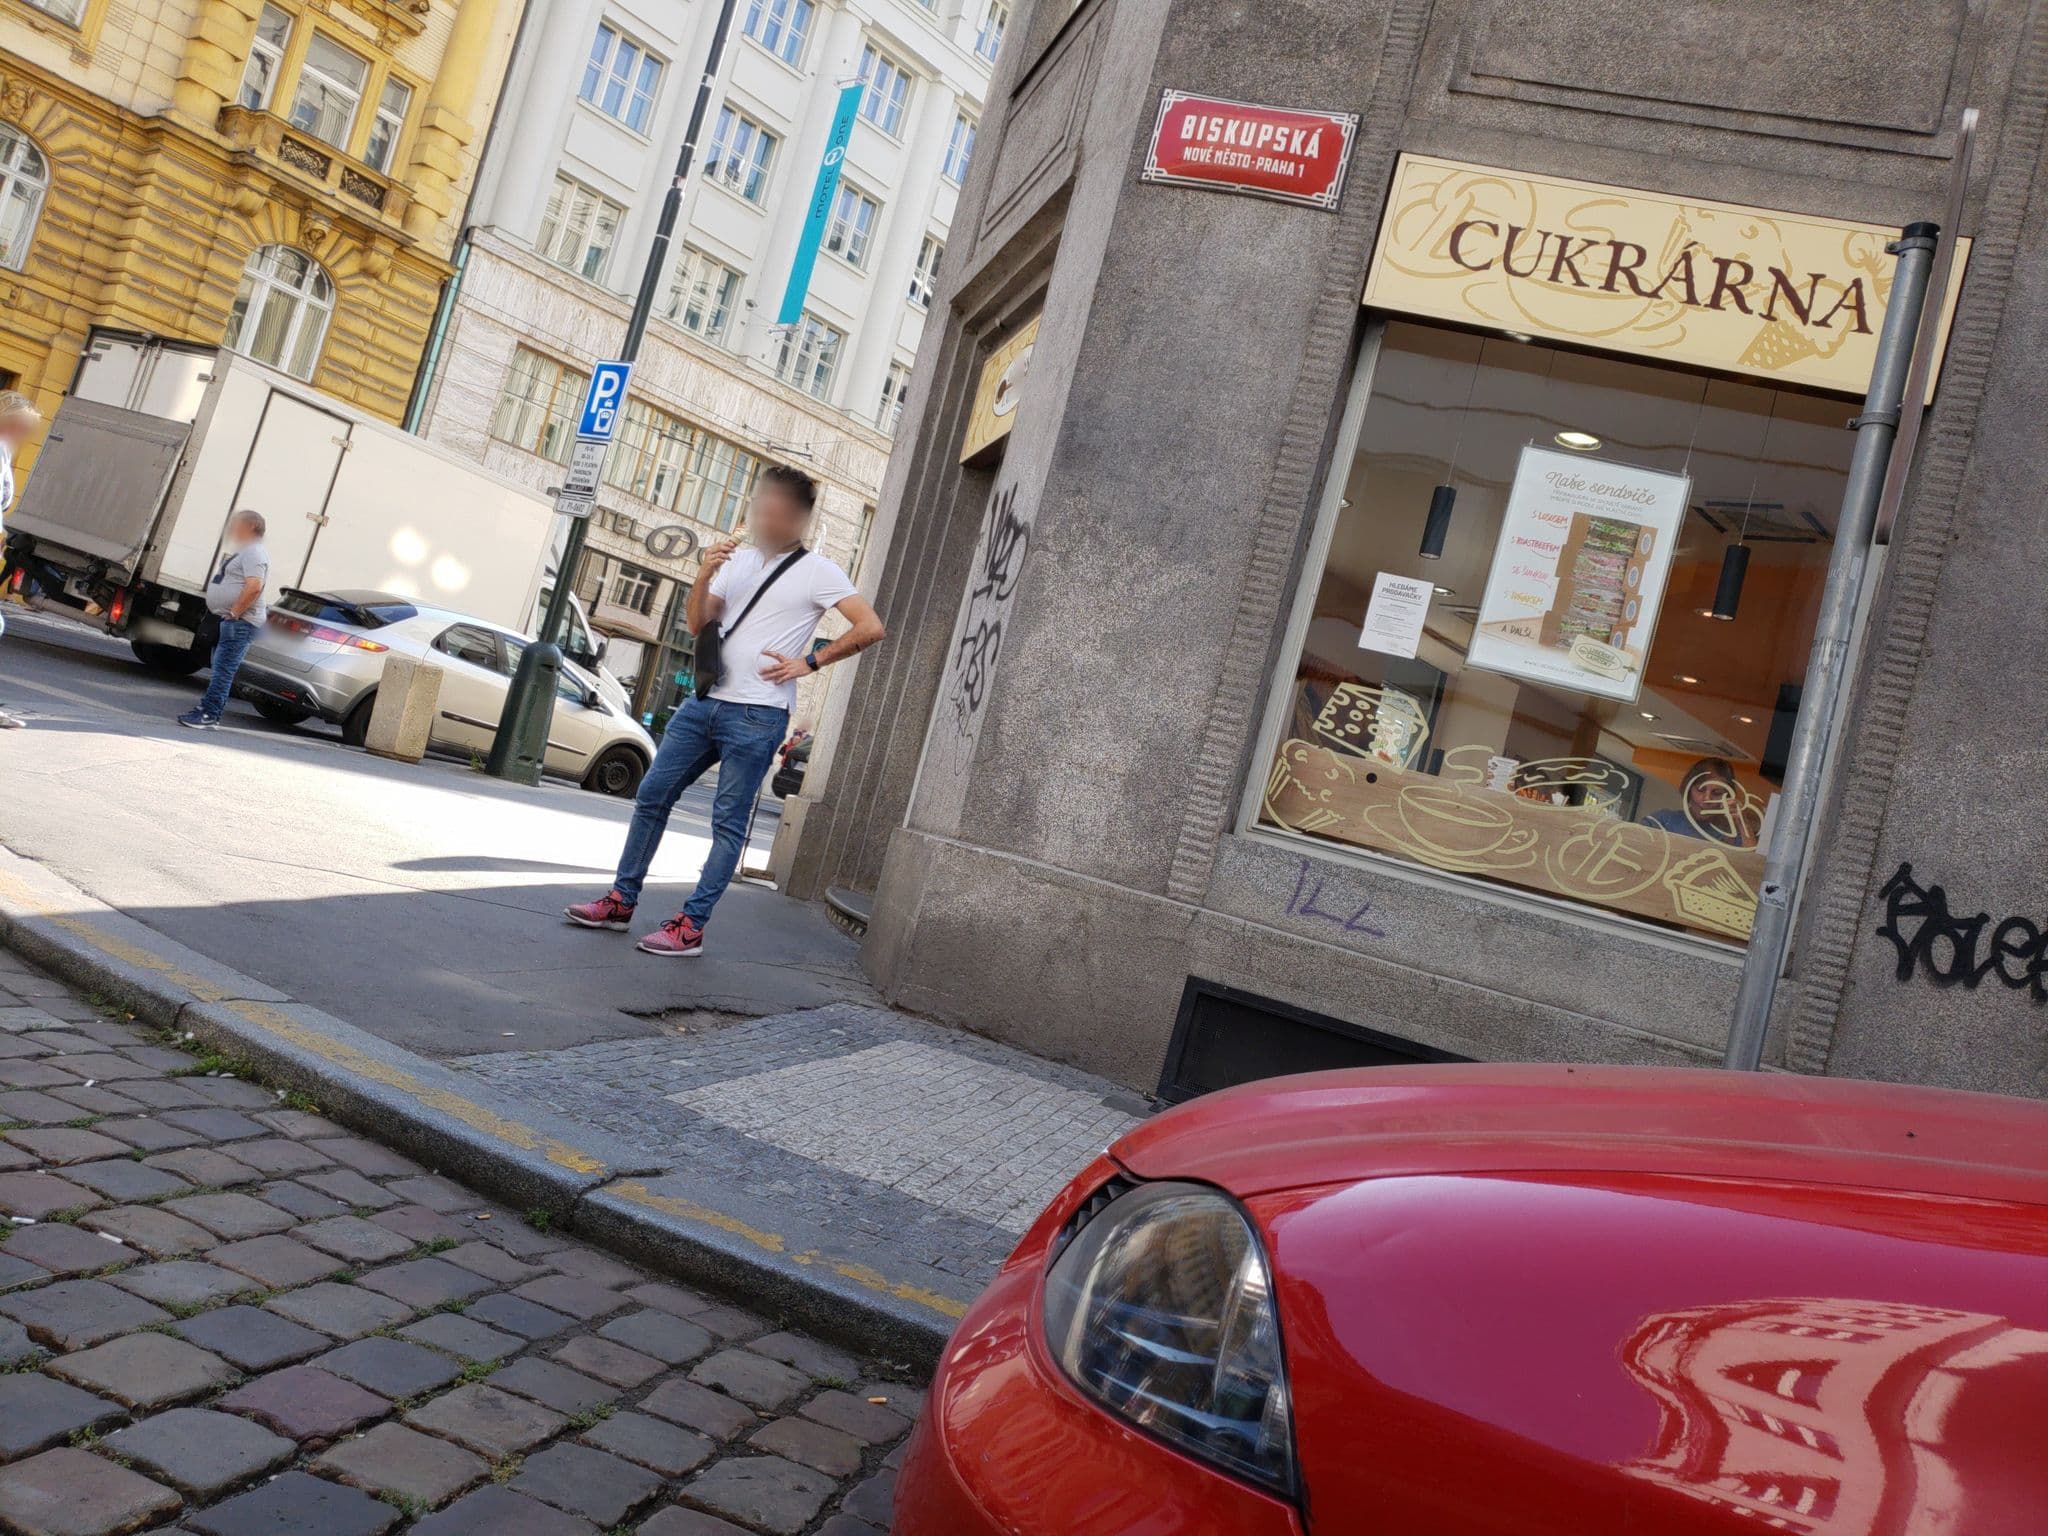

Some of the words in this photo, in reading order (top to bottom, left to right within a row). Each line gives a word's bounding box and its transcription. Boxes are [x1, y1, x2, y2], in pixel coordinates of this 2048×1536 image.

[1180, 114, 1324, 159] BISKUPSKÁ
[815, 167, 834, 219] MOTEL
[835, 114, 849, 146] ONE
[1183, 145, 1213, 163] NOVÉ
[1298, 163, 1305, 178] 1
[1448, 219, 1875, 336] CUKRÁRNA
[590, 370, 620, 414] P
[1545, 471, 1587, 490] Naše
[1589, 481, 1657, 505] sendviče
[1501, 625, 1507, 633] A
